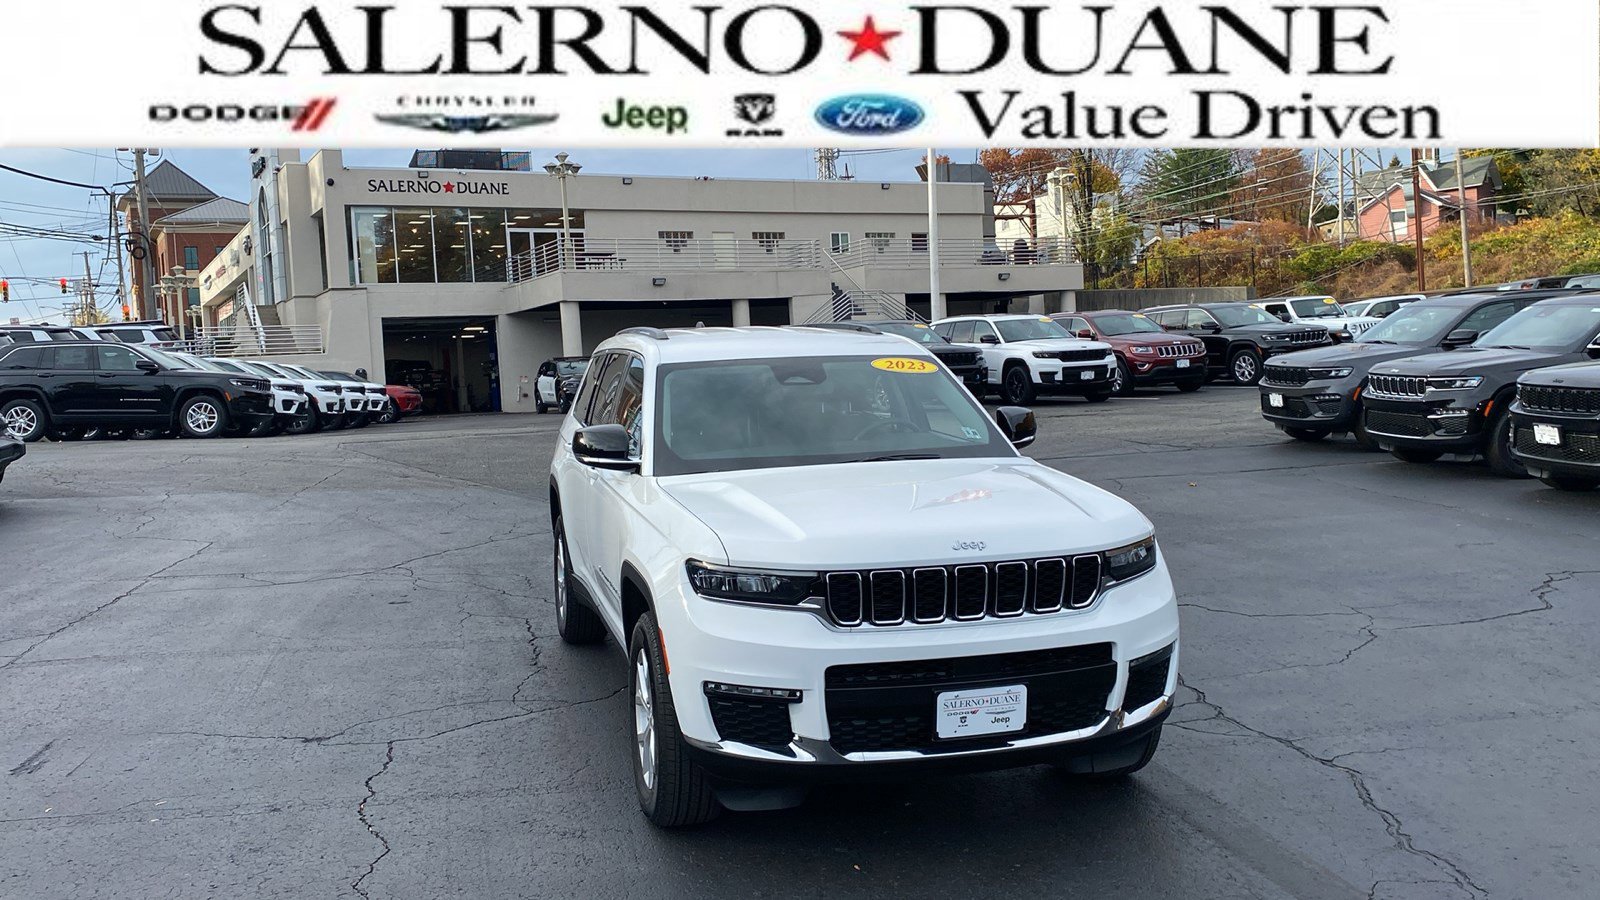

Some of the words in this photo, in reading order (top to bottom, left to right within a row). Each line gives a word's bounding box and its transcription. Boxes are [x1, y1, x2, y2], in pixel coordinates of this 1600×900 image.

[367, 179, 442, 194] SALERNO
[456, 181, 510, 195] DUANE
[885, 360, 926, 371] 2023
[951, 540, 986, 551] Jeep
[943, 698, 985, 710] SALERNO
[989, 694, 1021, 705] DUANE
[991, 716, 1011, 724] Jeep
